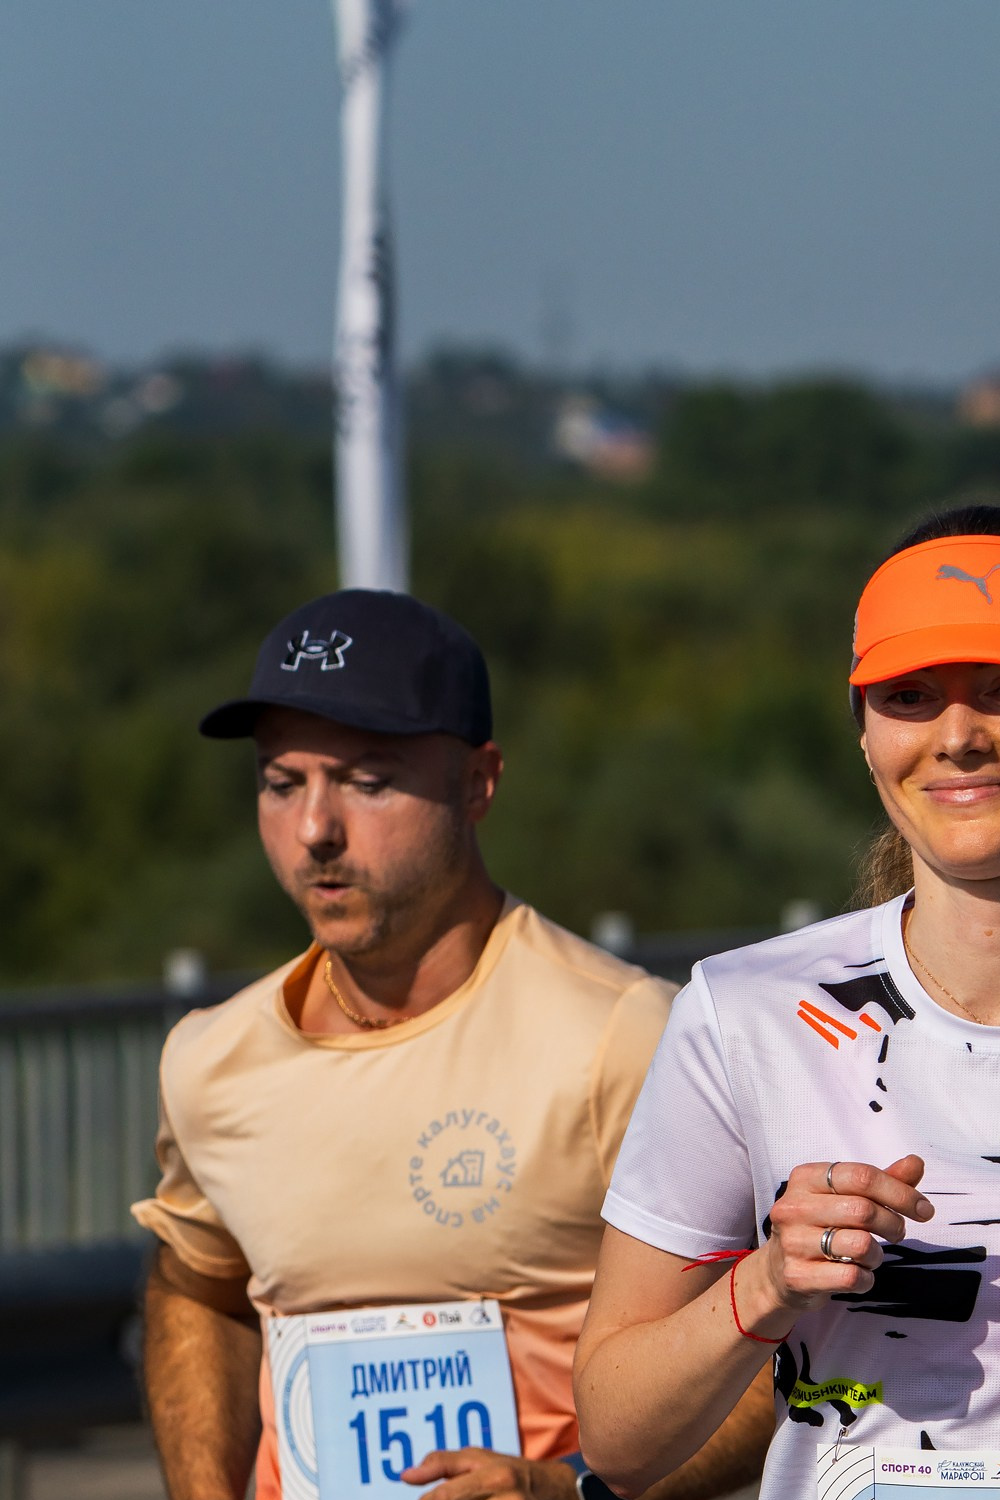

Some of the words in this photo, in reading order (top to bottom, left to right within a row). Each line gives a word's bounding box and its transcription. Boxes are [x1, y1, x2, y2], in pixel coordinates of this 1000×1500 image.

[408, 1155, 464, 1228] спорте
[471, 1196, 501, 1224] на
[351, 1350, 473, 1398] ДМИТРИЙ
[849, 1387, 877, 1402] TEAM
[349, 1400, 493, 1485] 1510
[881, 1463, 916, 1474] СПОРТ
[918, 1465, 932, 1475] 40
[940, 1471, 985, 1481] МАРАФОН
